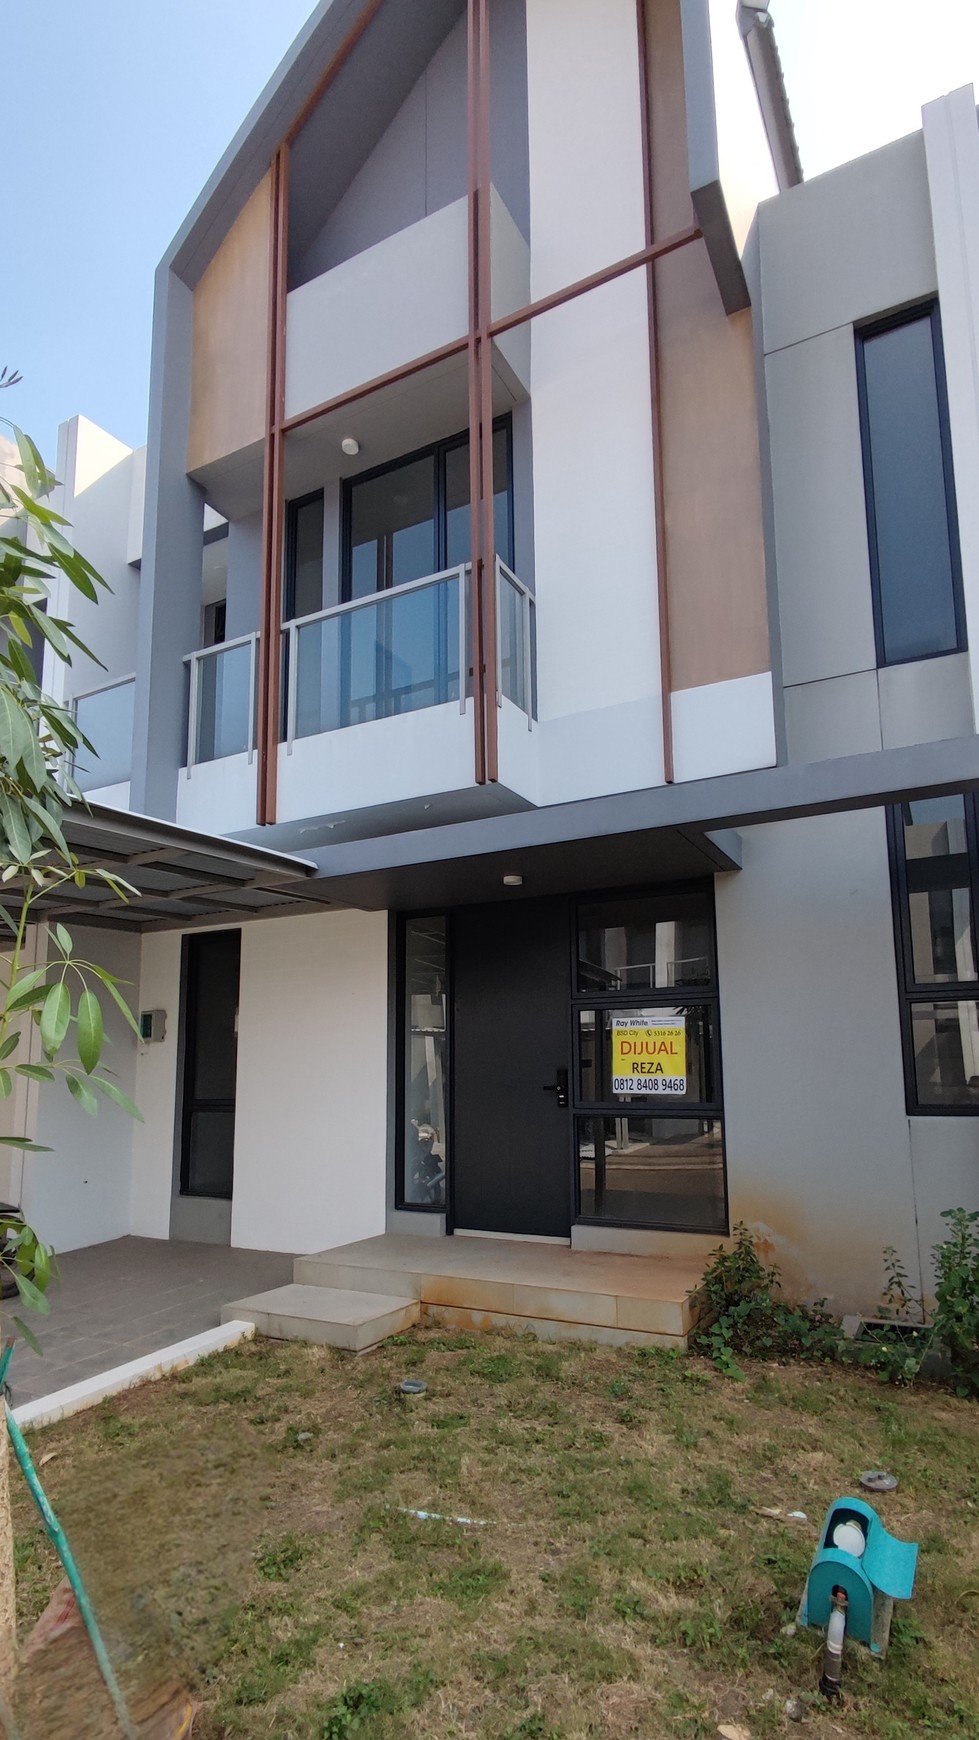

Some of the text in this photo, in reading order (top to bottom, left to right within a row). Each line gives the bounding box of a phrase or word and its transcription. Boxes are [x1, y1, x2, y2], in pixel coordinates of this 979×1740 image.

[621, 1041, 678, 1055] DIJUAL
[632, 1062, 663, 1073] REZA
[614, 1079, 684, 1091] 0812 8408 9468
